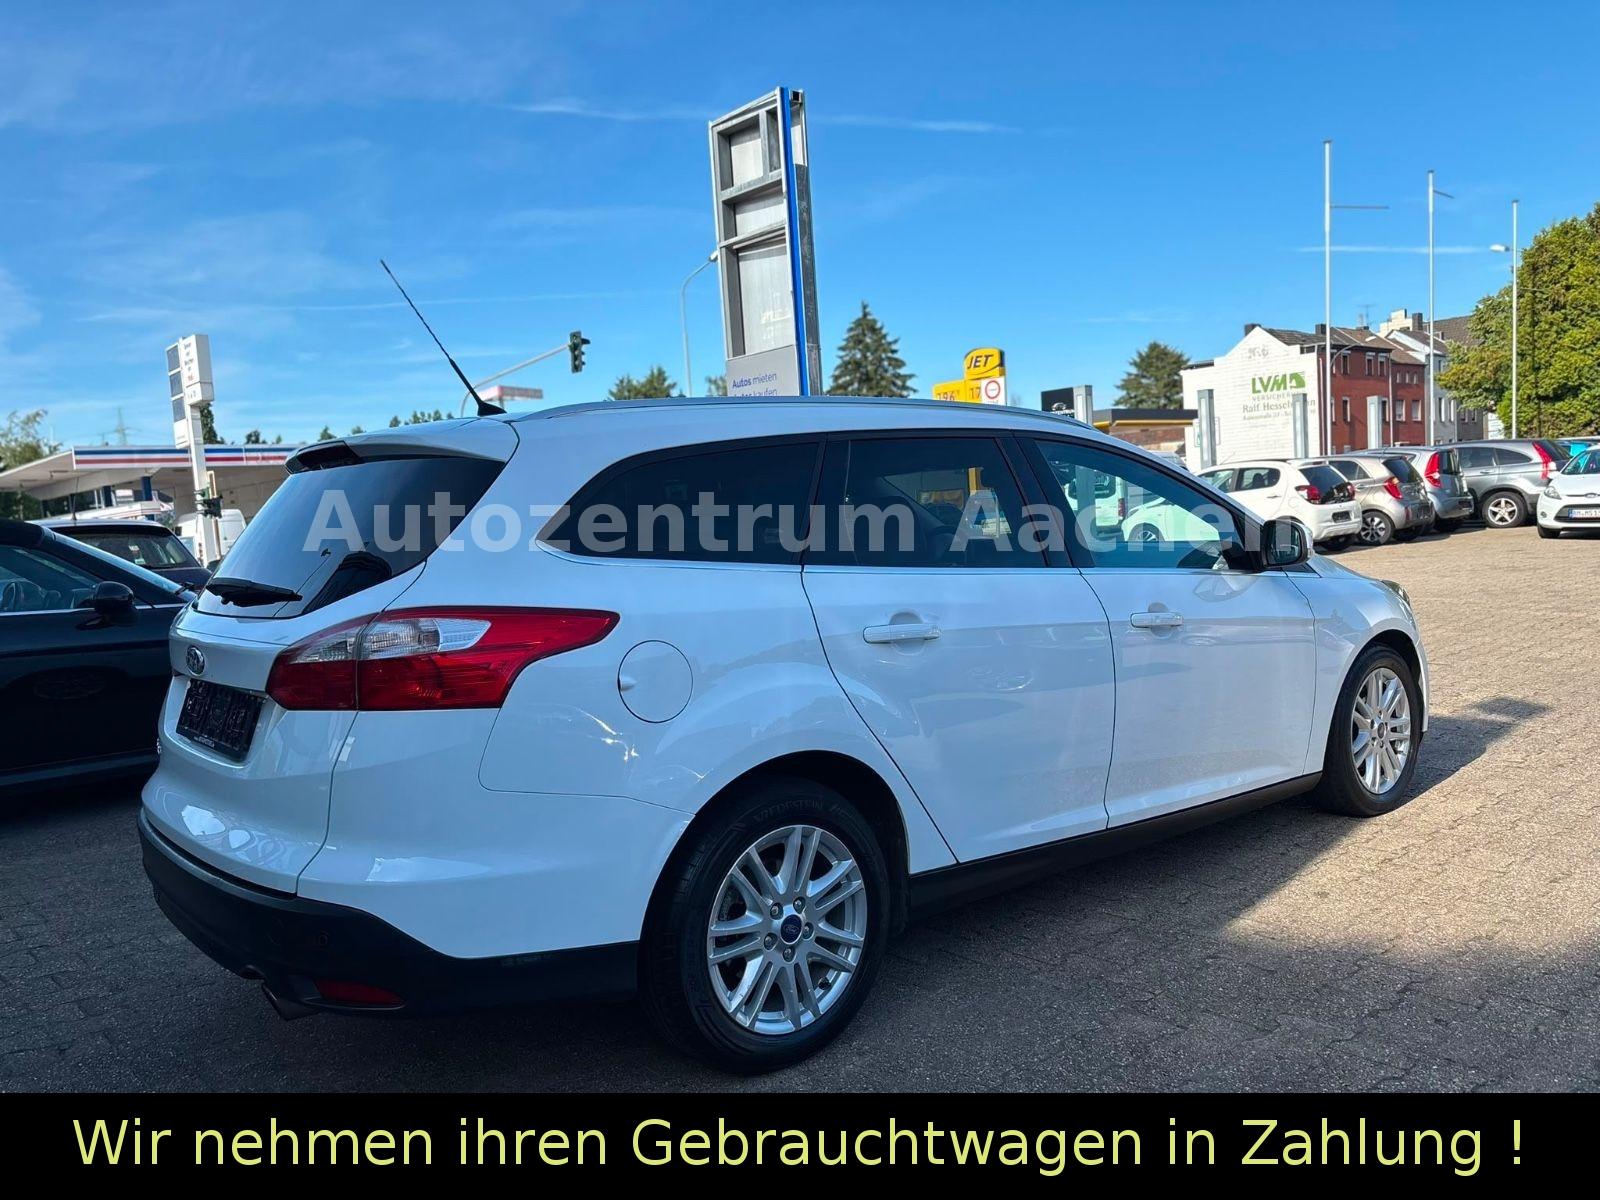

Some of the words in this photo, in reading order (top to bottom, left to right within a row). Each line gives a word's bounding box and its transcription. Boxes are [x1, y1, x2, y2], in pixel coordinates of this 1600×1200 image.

[967, 354, 995, 370] JET
[732, 378, 751, 389] Autos
[1251, 373, 1287, 394] LVM
